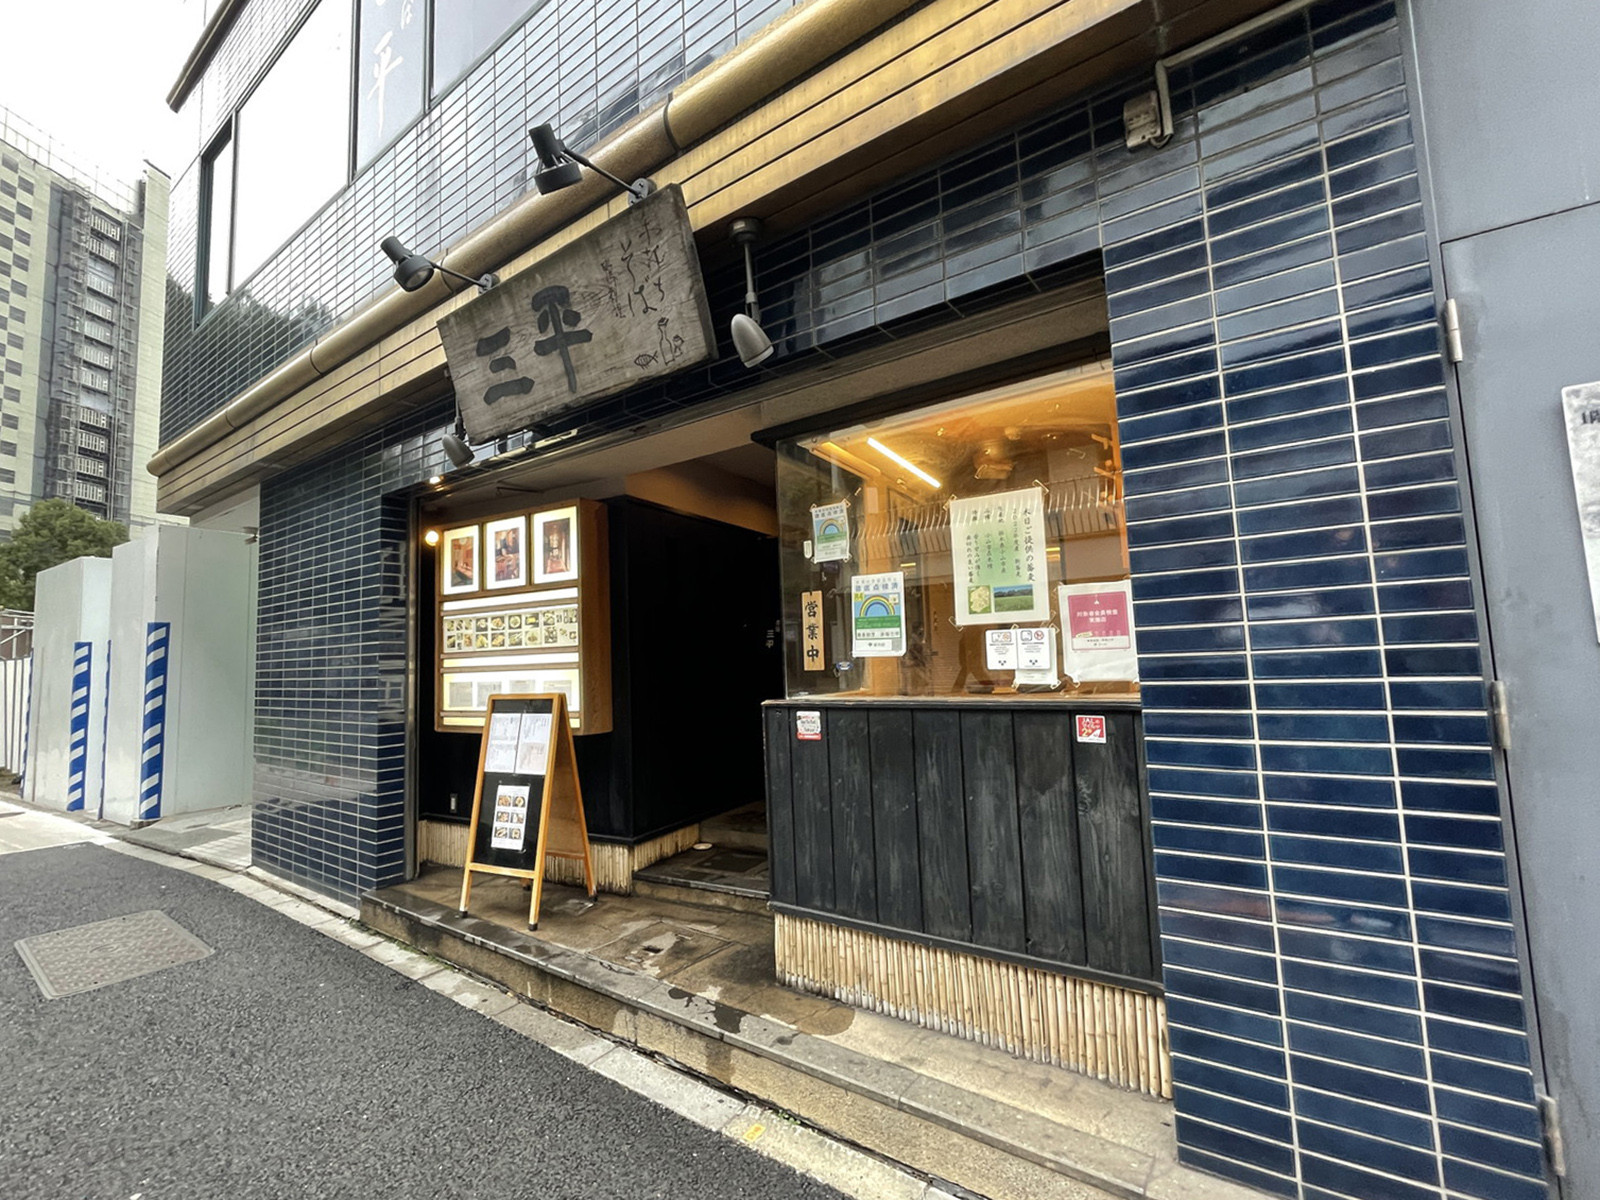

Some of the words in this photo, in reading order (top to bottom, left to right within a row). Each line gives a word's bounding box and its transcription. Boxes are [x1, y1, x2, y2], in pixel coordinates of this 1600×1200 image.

[475, 284, 594, 406] 三平
[804, 600, 820, 663] 営業中
